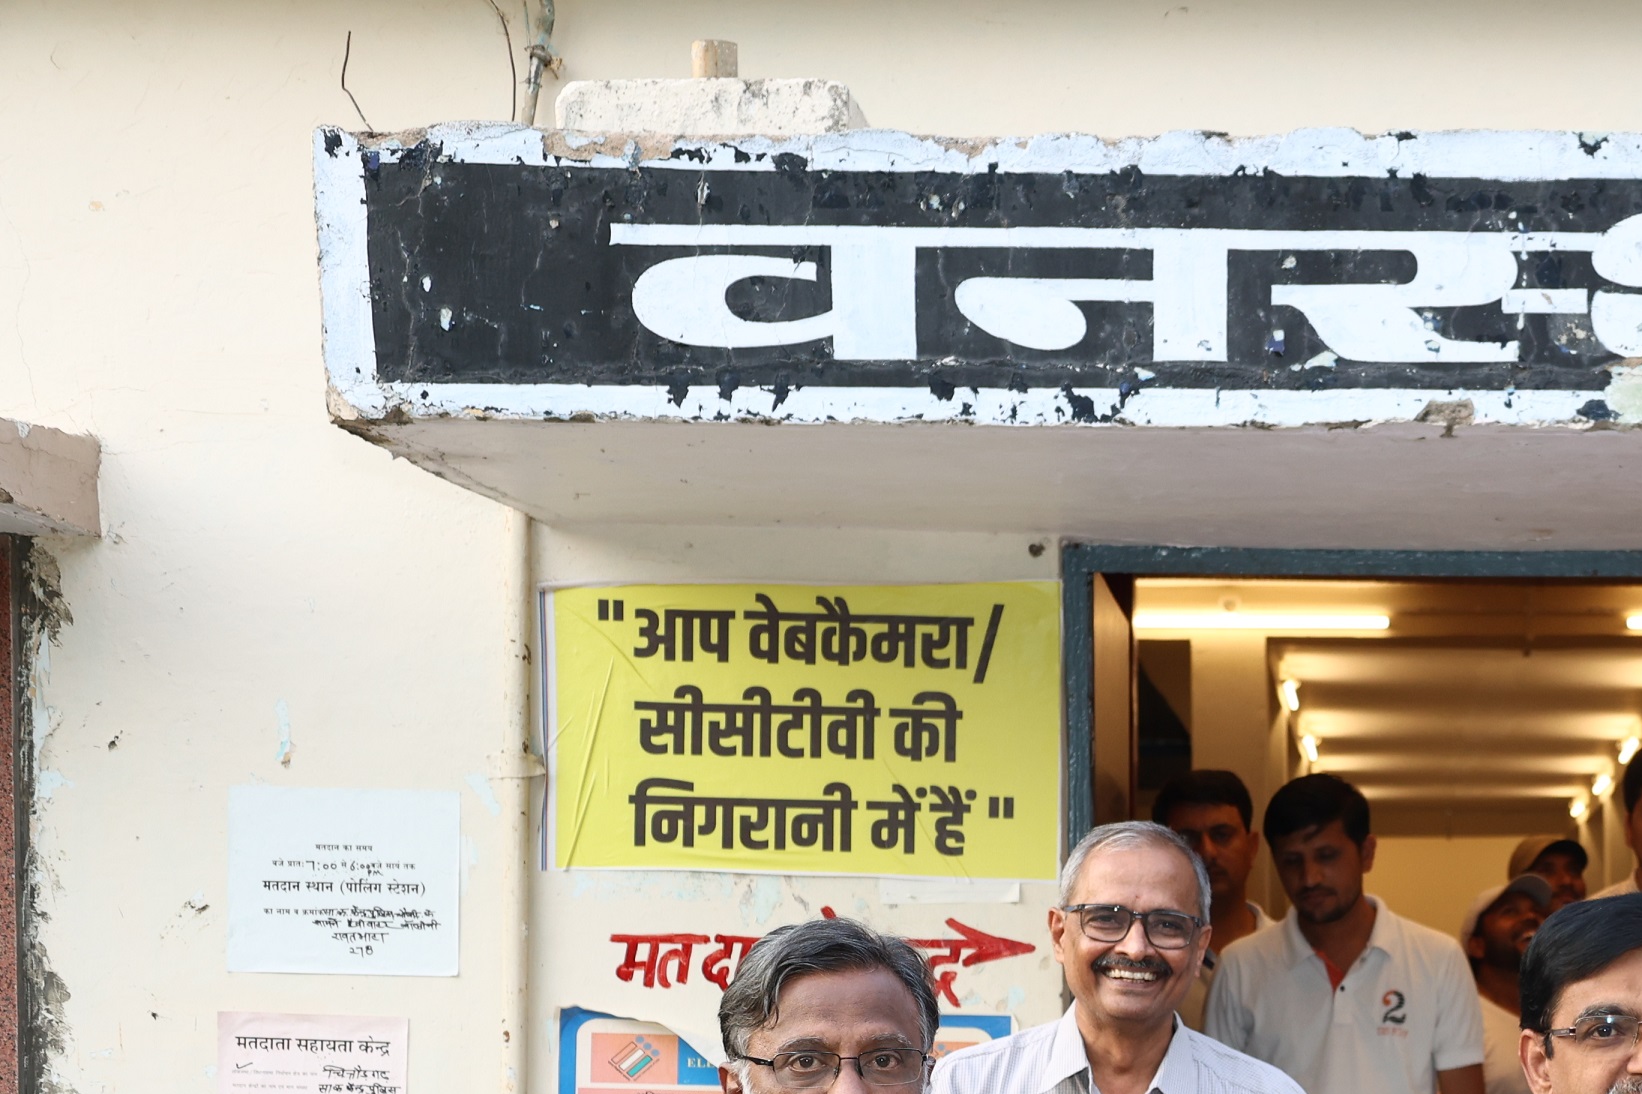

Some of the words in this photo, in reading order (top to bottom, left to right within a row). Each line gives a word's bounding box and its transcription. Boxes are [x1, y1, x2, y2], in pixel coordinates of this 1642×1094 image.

[634, 685, 880, 761] सीसीटीवी
[889, 692, 962, 763] की
[629, 778, 857, 852] निगरानी
[867, 784, 927, 855] में
[262, 880, 301, 893] मतदान
[305, 881, 334, 892] स्थान
[235, 1036, 291, 1052] मतदाता
[295, 1037, 353, 1054] सहायता
[358, 1035, 391, 1056] केन्द्र
